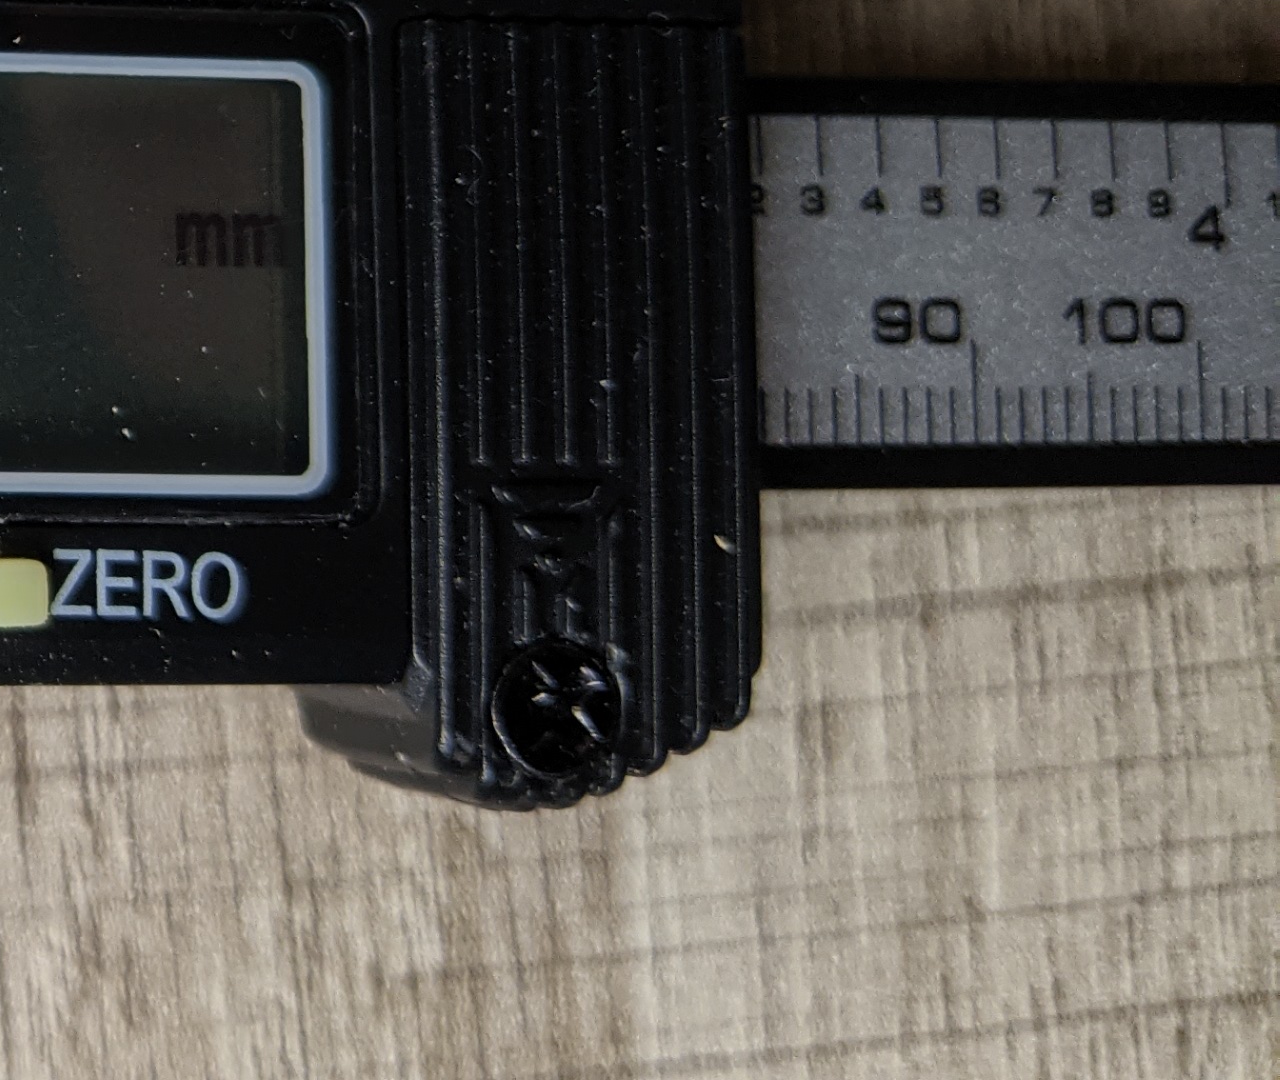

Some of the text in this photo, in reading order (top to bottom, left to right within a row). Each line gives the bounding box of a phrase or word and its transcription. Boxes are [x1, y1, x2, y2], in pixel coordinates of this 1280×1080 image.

[175, 213, 283, 266] mm
[800, 184, 826, 216] 3
[860, 186, 886, 215] 4
[919, 186, 945, 216] 5
[977, 187, 1001, 217] 6
[1033, 187, 1059, 217] 7
[1090, 188, 1116, 218] 8
[1147, 188, 1172, 218] 9
[1188, 204, 1226, 252] 4
[871, 296, 1187, 346] 90 100
[51, 547, 242, 623] ZERO
